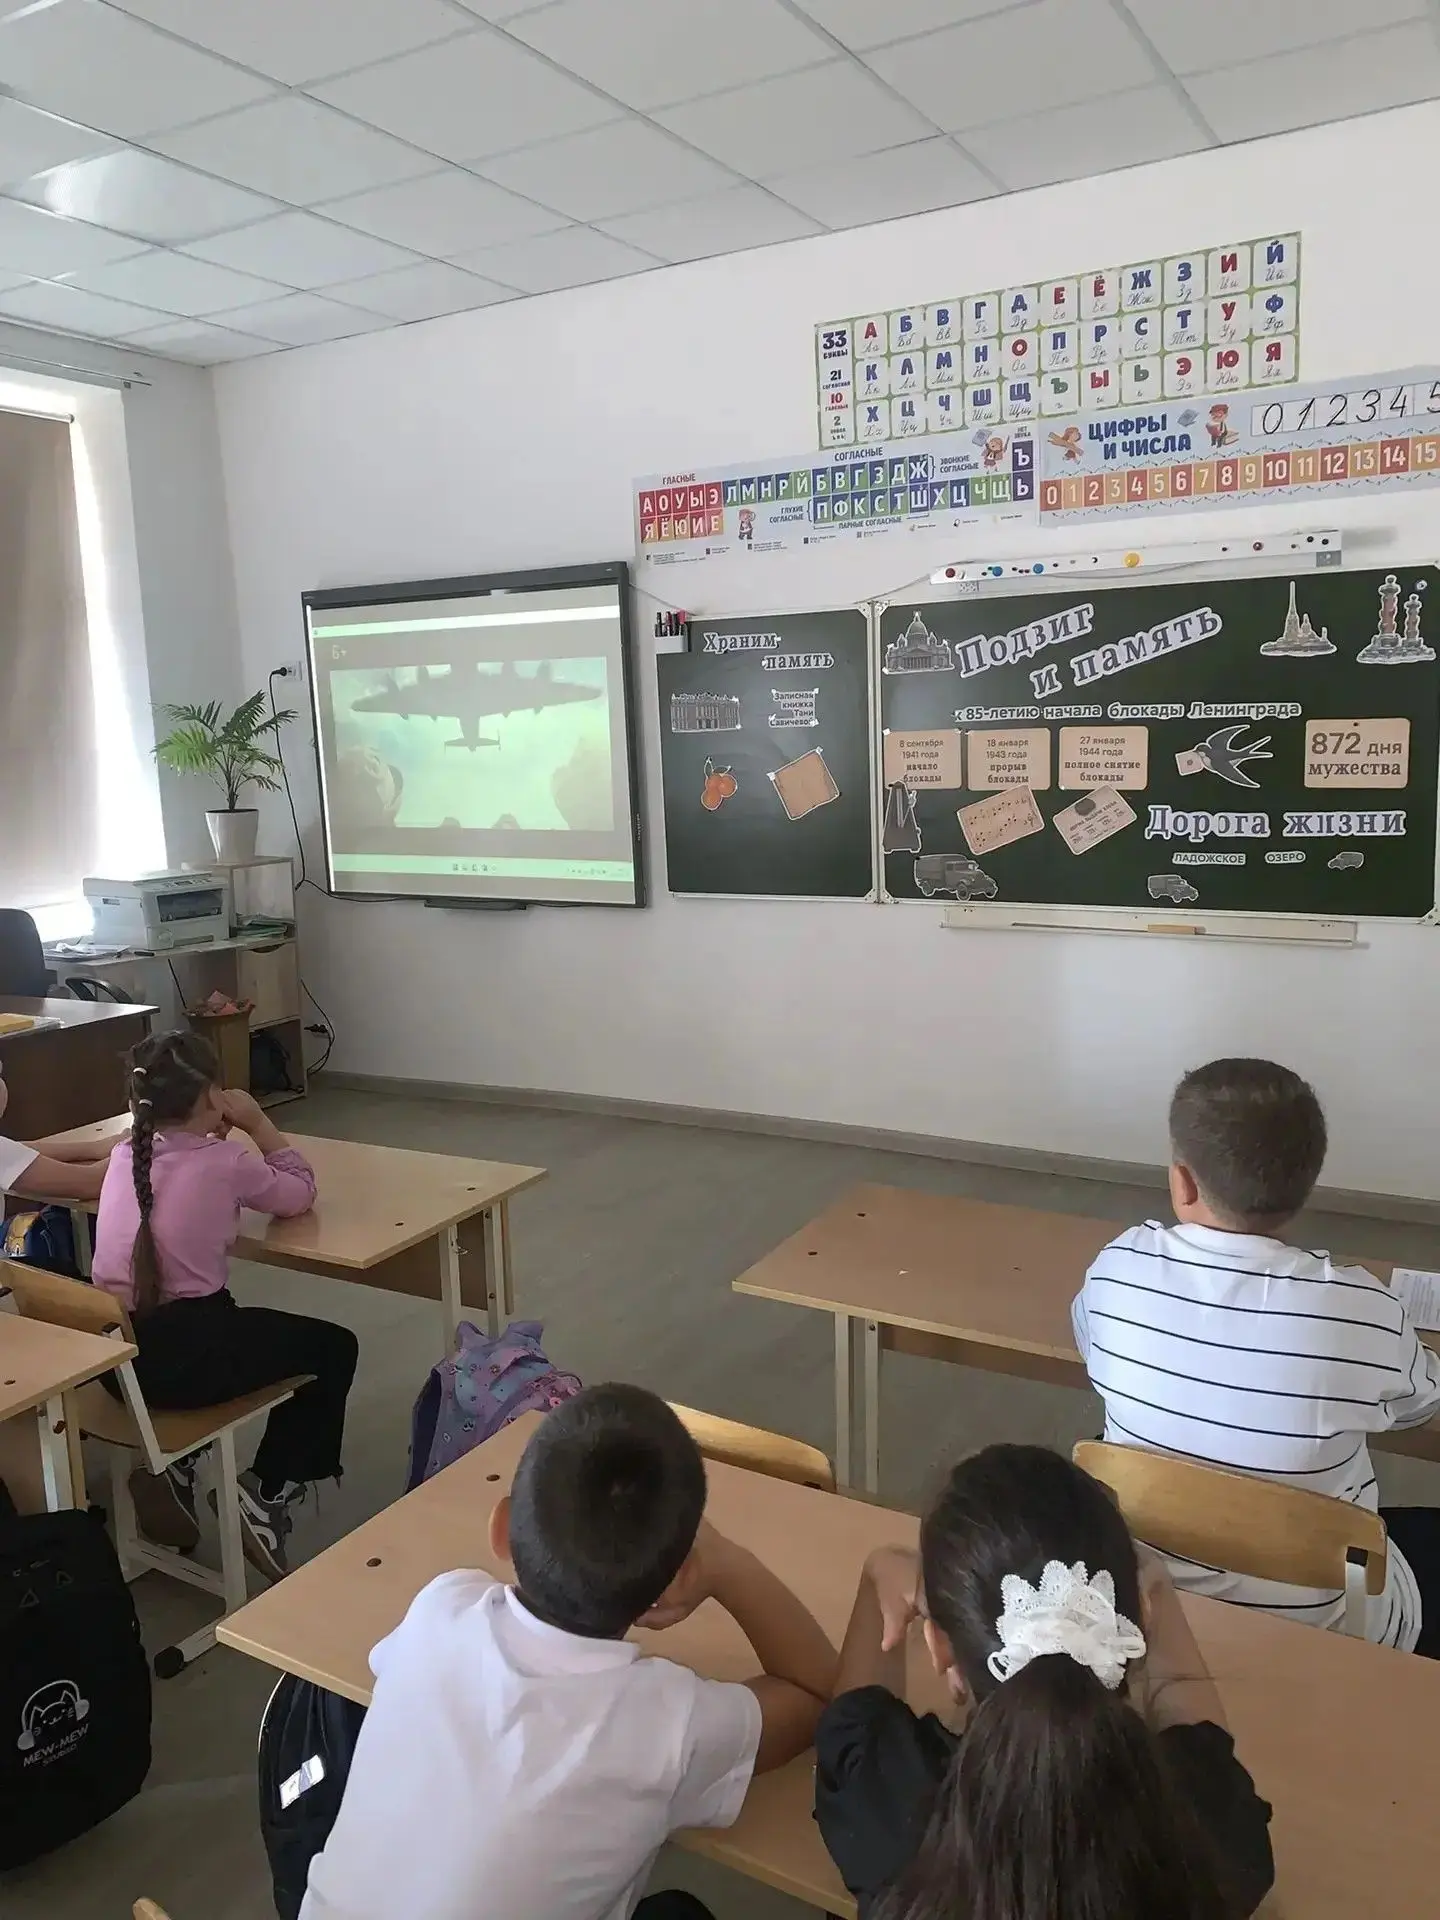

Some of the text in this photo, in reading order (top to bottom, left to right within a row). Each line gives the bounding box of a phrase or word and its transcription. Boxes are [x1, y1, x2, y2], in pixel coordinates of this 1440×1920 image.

[864, 240, 1284, 338] А Б В Г Д Е Ё Ж З И Й
[822, 330, 847, 349] 33
[866, 294, 1284, 381] К Л М Н О П Р С Т У Ф
[830, 370, 842, 380] 21
[867, 343, 1281, 423] Х Ц Ч Ш Щ Ъ Ы Ь Э Ю Я
[830, 393, 843, 403] 10
[1263, 381, 1440, 434] 0 1 2 3 4 5
[834, 416, 841, 426] 2
[1088, 414, 1167, 441] ЦИФРЫ
[835, 447, 883, 461] СОГЛАСНЫЕ
[1104, 434, 1191, 460] И ЧИСЛА
[940, 455, 970, 465] ЗВОНКИЕ
[1014, 449, 1030, 465] Ъ
[940, 462, 979, 473] СОГЛАСНЫЕ
[1047, 442, 1437, 504] 0 1 2 3 4 5 6 7 8 9 10 11 12 13 14 15
[643, 460, 927, 513] А О У Ы Э Л М Н Р Й Б В Г З Д Ж
[662, 473, 696, 484] ГЛАСНЫЕ
[1017, 480, 1029, 496] Ь
[817, 482, 1011, 519] П Ф К С Т Ш Х Ц Ч Щ
[769, 513, 804, 523] СОГЛАСНЫЕ
[781, 506, 803, 514] ГЛУХИЕ
[645, 515, 719, 538] Я Ё Ю И Е
[839, 516, 902, 530] ПАРНЫЕ СОГЛАСНЫЕ
[705, 634, 776, 652] Храним
[959, 607, 1091, 675] Подвиг
[1034, 611, 1219, 694] и память
[766, 655, 832, 668] память
[957, 703, 1300, 720] к 85-летию начала блокады Ленинграда
[906, 740, 943, 748] сентября
[998, 740, 1028, 748] января
[1080, 736, 1090, 744] 27
[1311, 733, 1402, 756] 872 дня
[990, 764, 1027, 772] прорыв
[1308, 761, 1401, 777] мужества
[904, 774, 941, 783] блокады
[988, 775, 1029, 783] блокады
[1080, 772, 1124, 781] блокады
[1147, 808, 1267, 839] Дорога
[1286, 814, 1403, 833] жизни
[1174, 853, 1304, 863] ЛАДОЖСКОЕ ОЗЕРО
[23, 1724, 88, 1767] MEW-MEW
